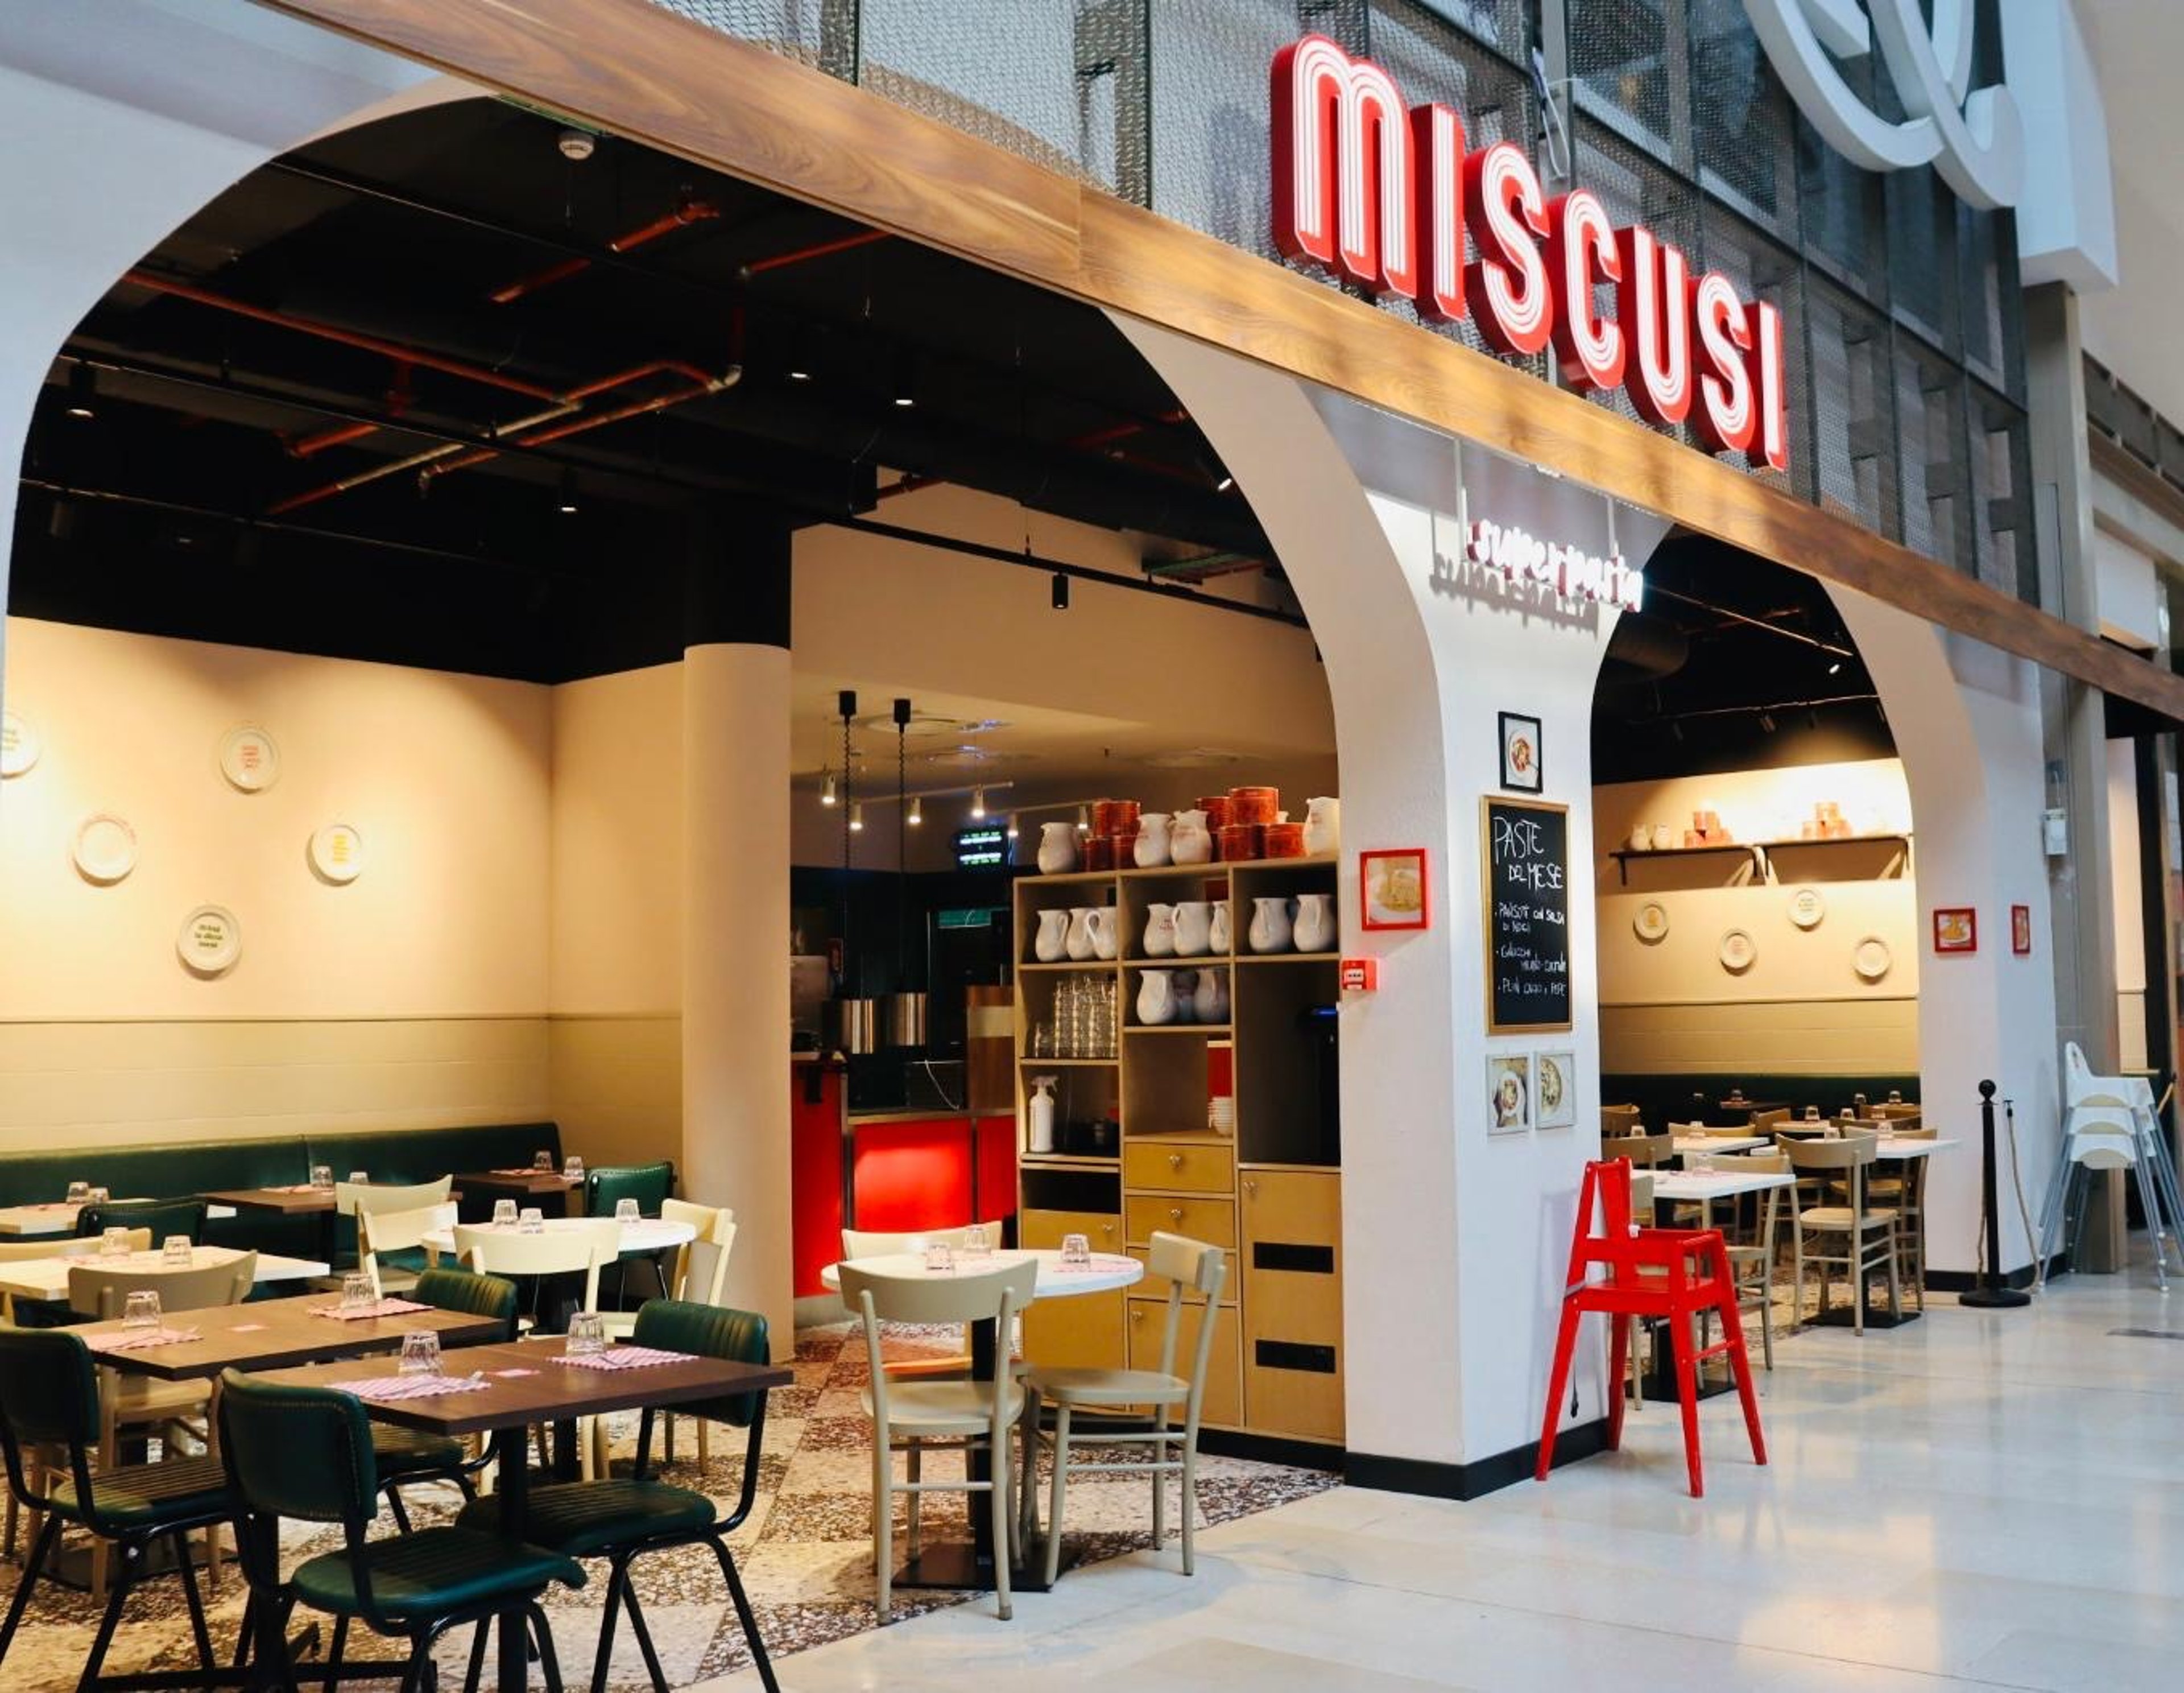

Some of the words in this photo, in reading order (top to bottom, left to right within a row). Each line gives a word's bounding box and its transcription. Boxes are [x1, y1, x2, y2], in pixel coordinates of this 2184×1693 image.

[1271, 33, 1786, 472] MISCUSI
[1492, 816, 1544, 865] PASTE
[1527, 861, 1563, 891] MESE
